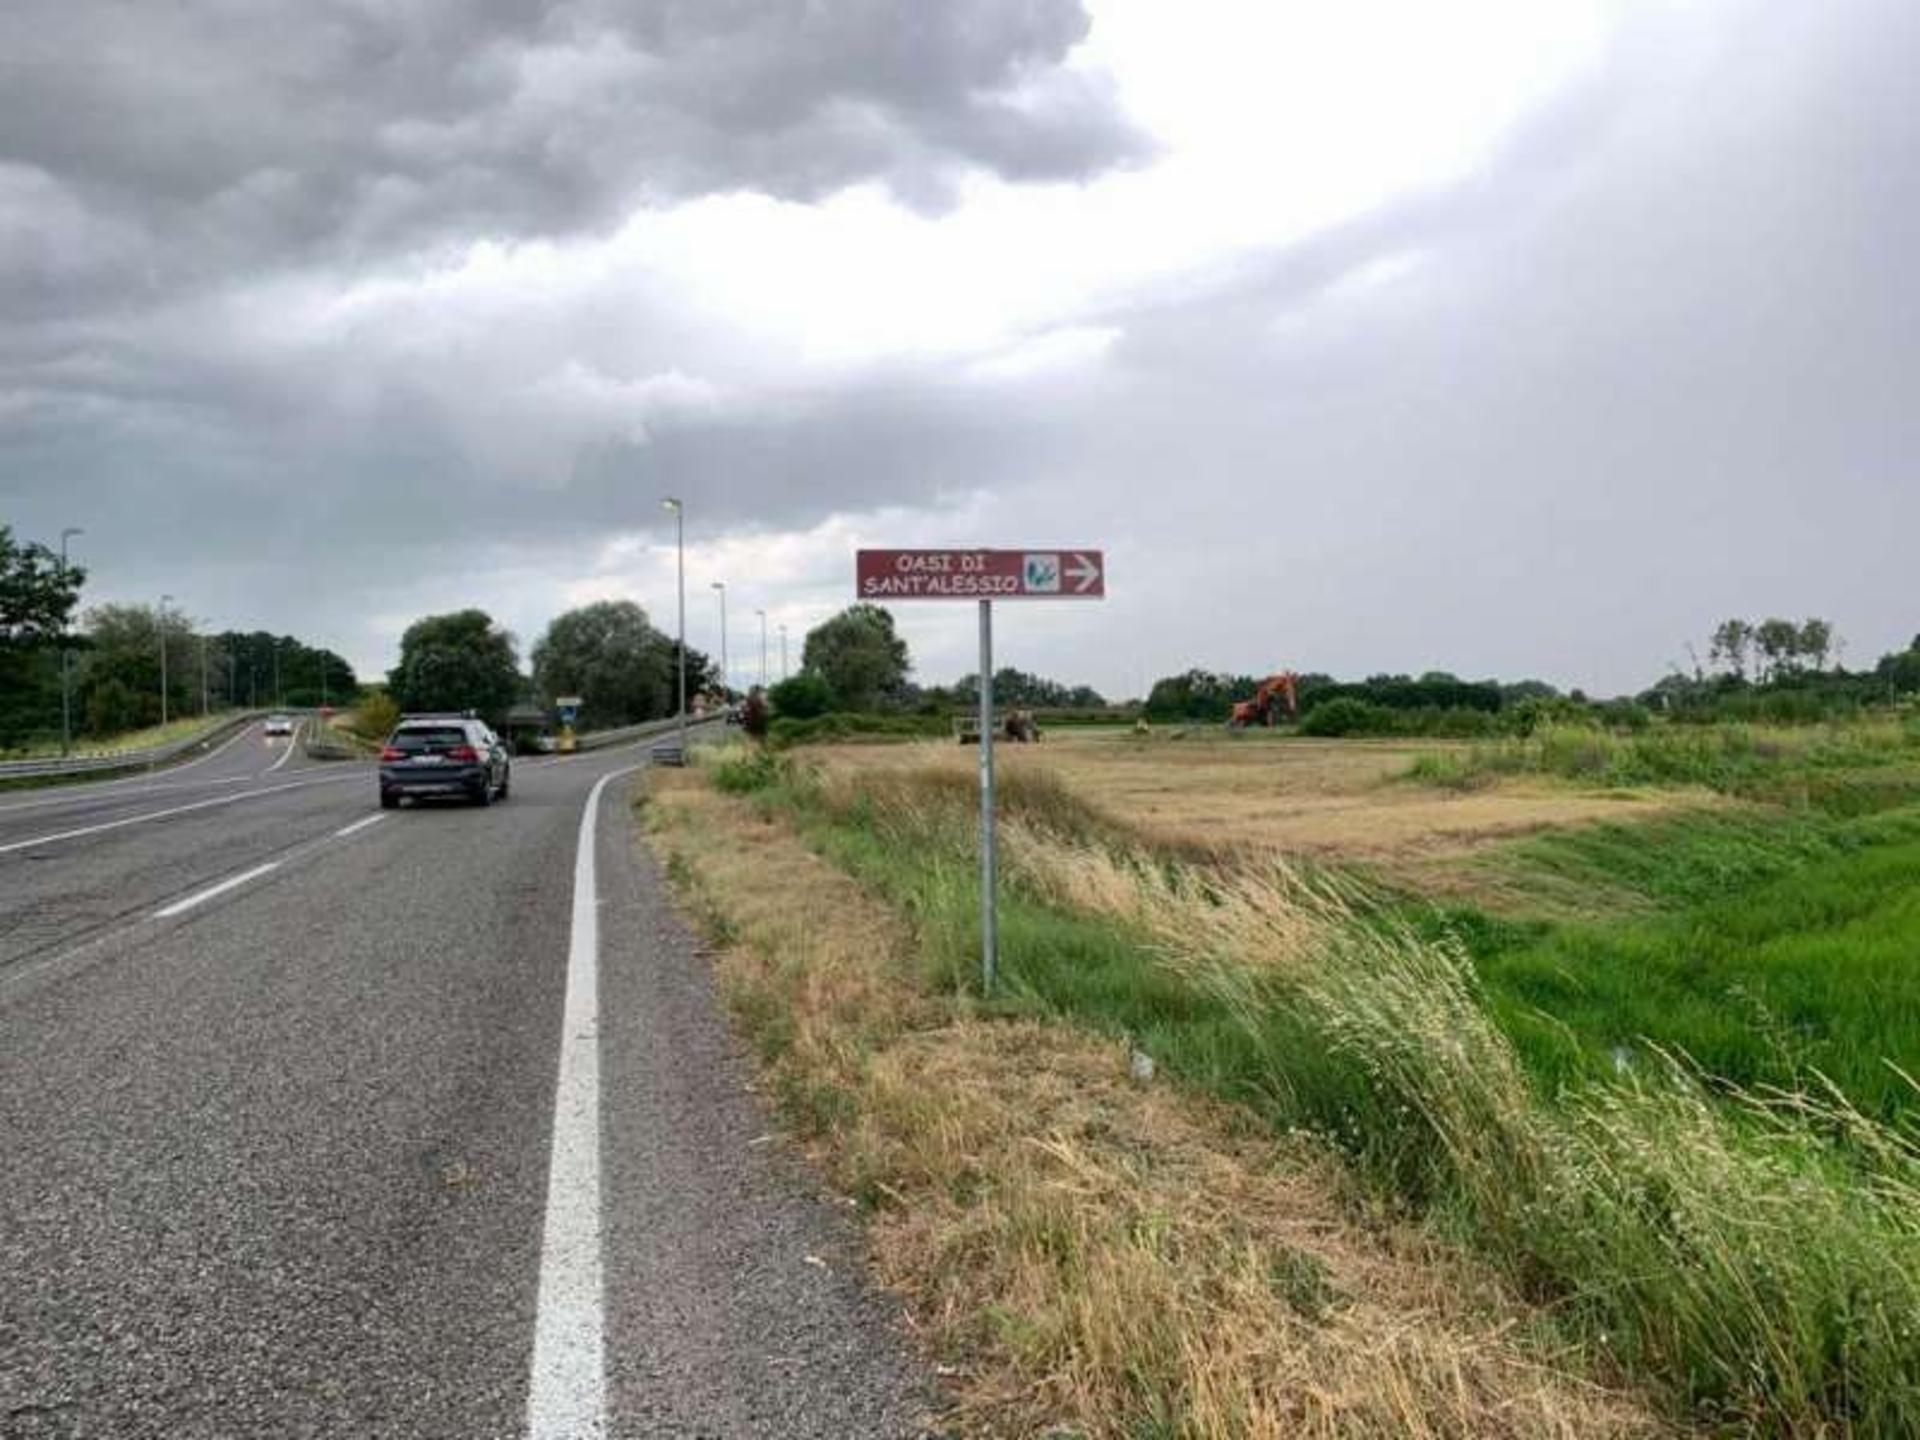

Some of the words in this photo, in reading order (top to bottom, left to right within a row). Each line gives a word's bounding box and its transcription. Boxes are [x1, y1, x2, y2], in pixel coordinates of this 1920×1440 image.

[895, 554, 950, 572] OASI
[961, 554, 986, 572] DI
[863, 576, 1018, 594] SANT'ALESSIO
